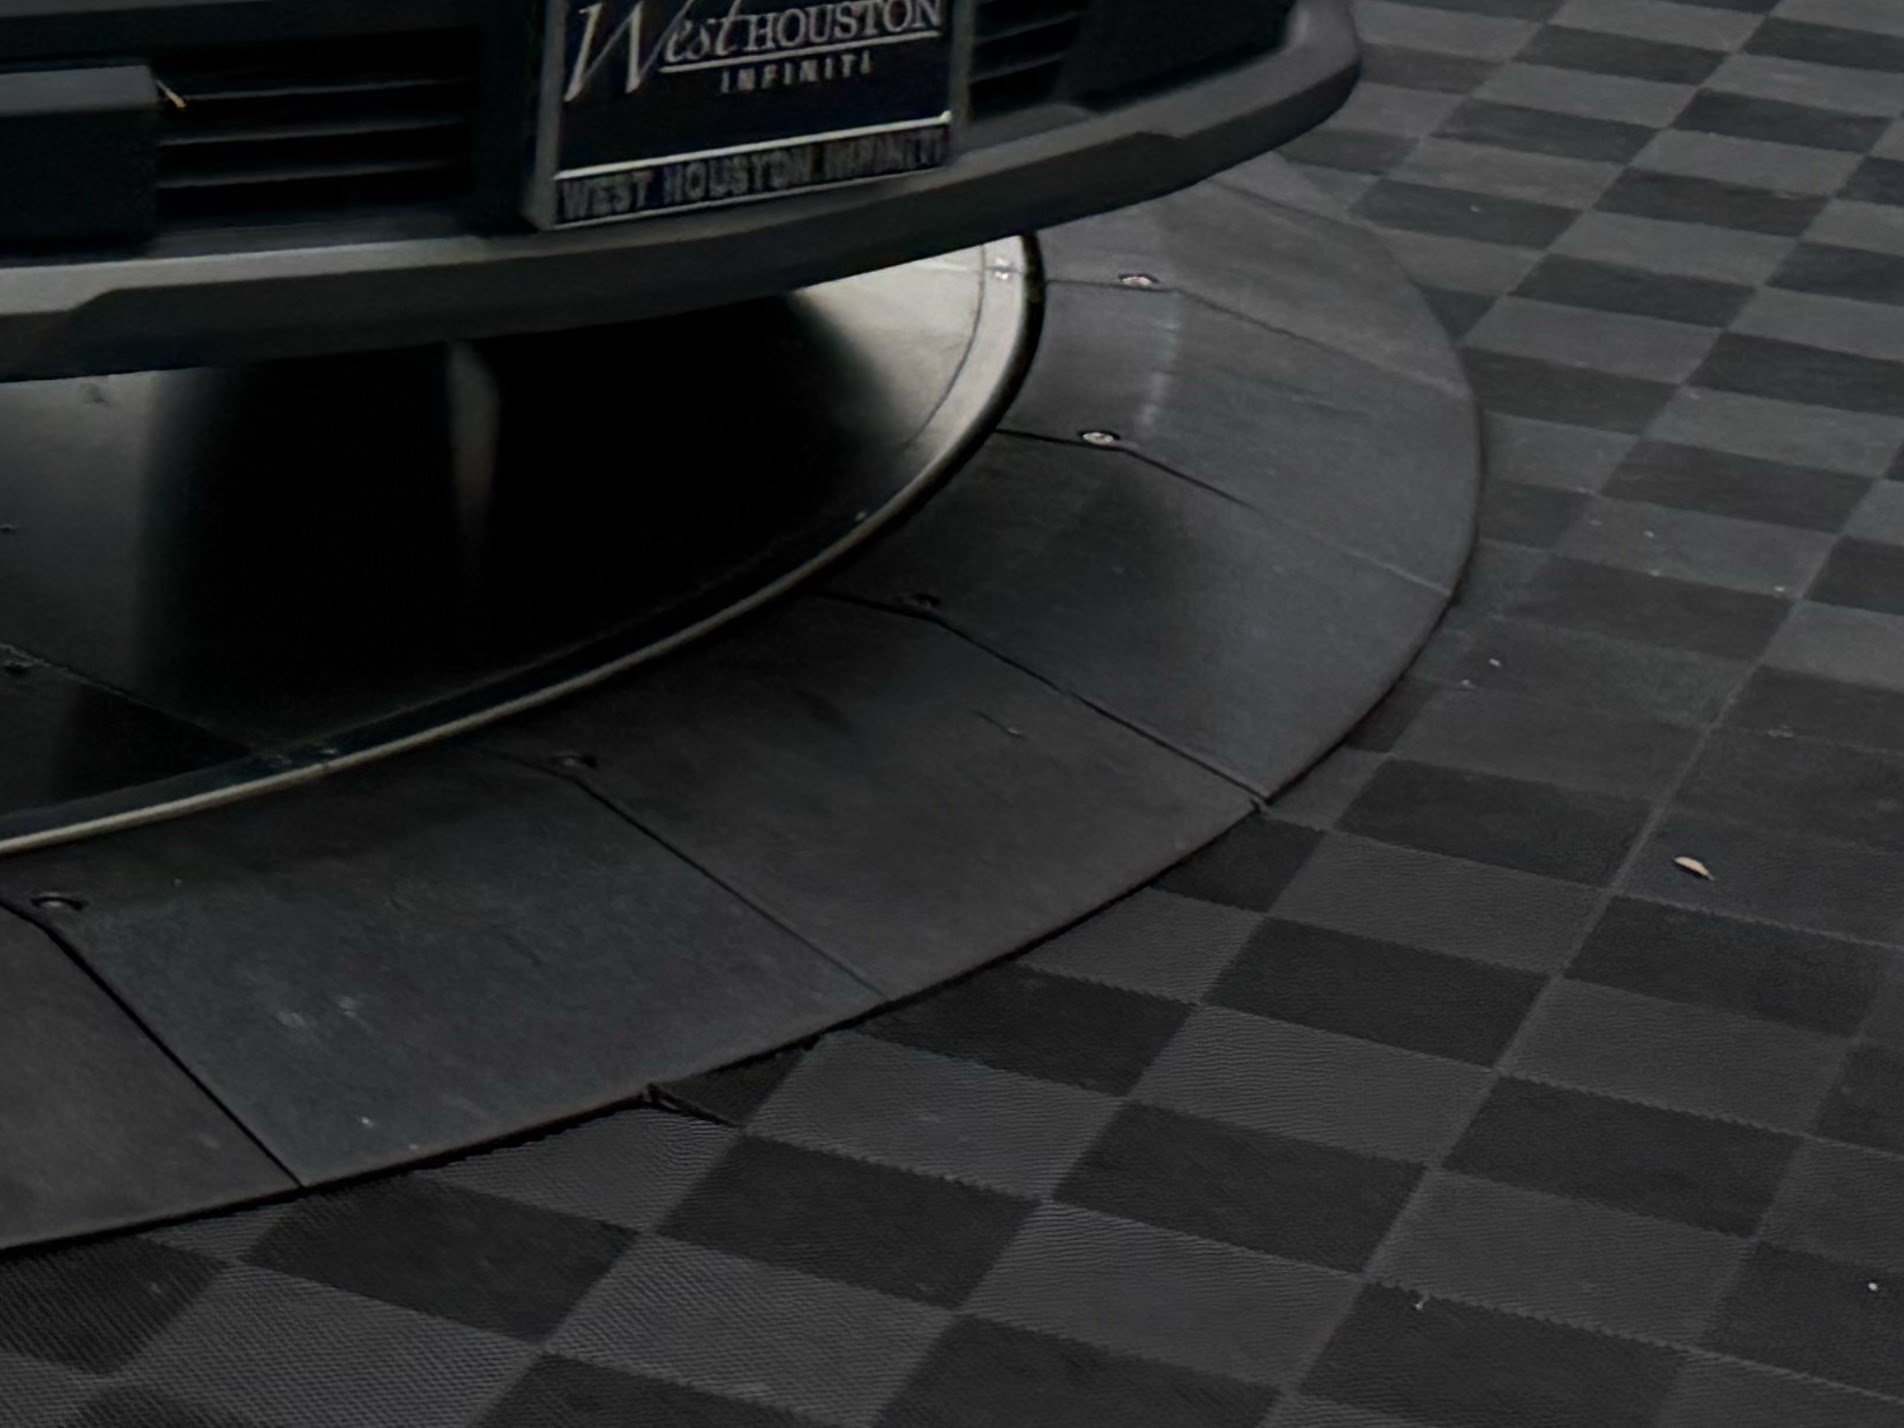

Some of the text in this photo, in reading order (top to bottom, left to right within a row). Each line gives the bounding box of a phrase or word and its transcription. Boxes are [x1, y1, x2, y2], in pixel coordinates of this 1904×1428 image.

[720, 52, 873, 93] INFINITI
[559, 170, 652, 220] WEST
[664, 148, 813, 206] HOUSTON
